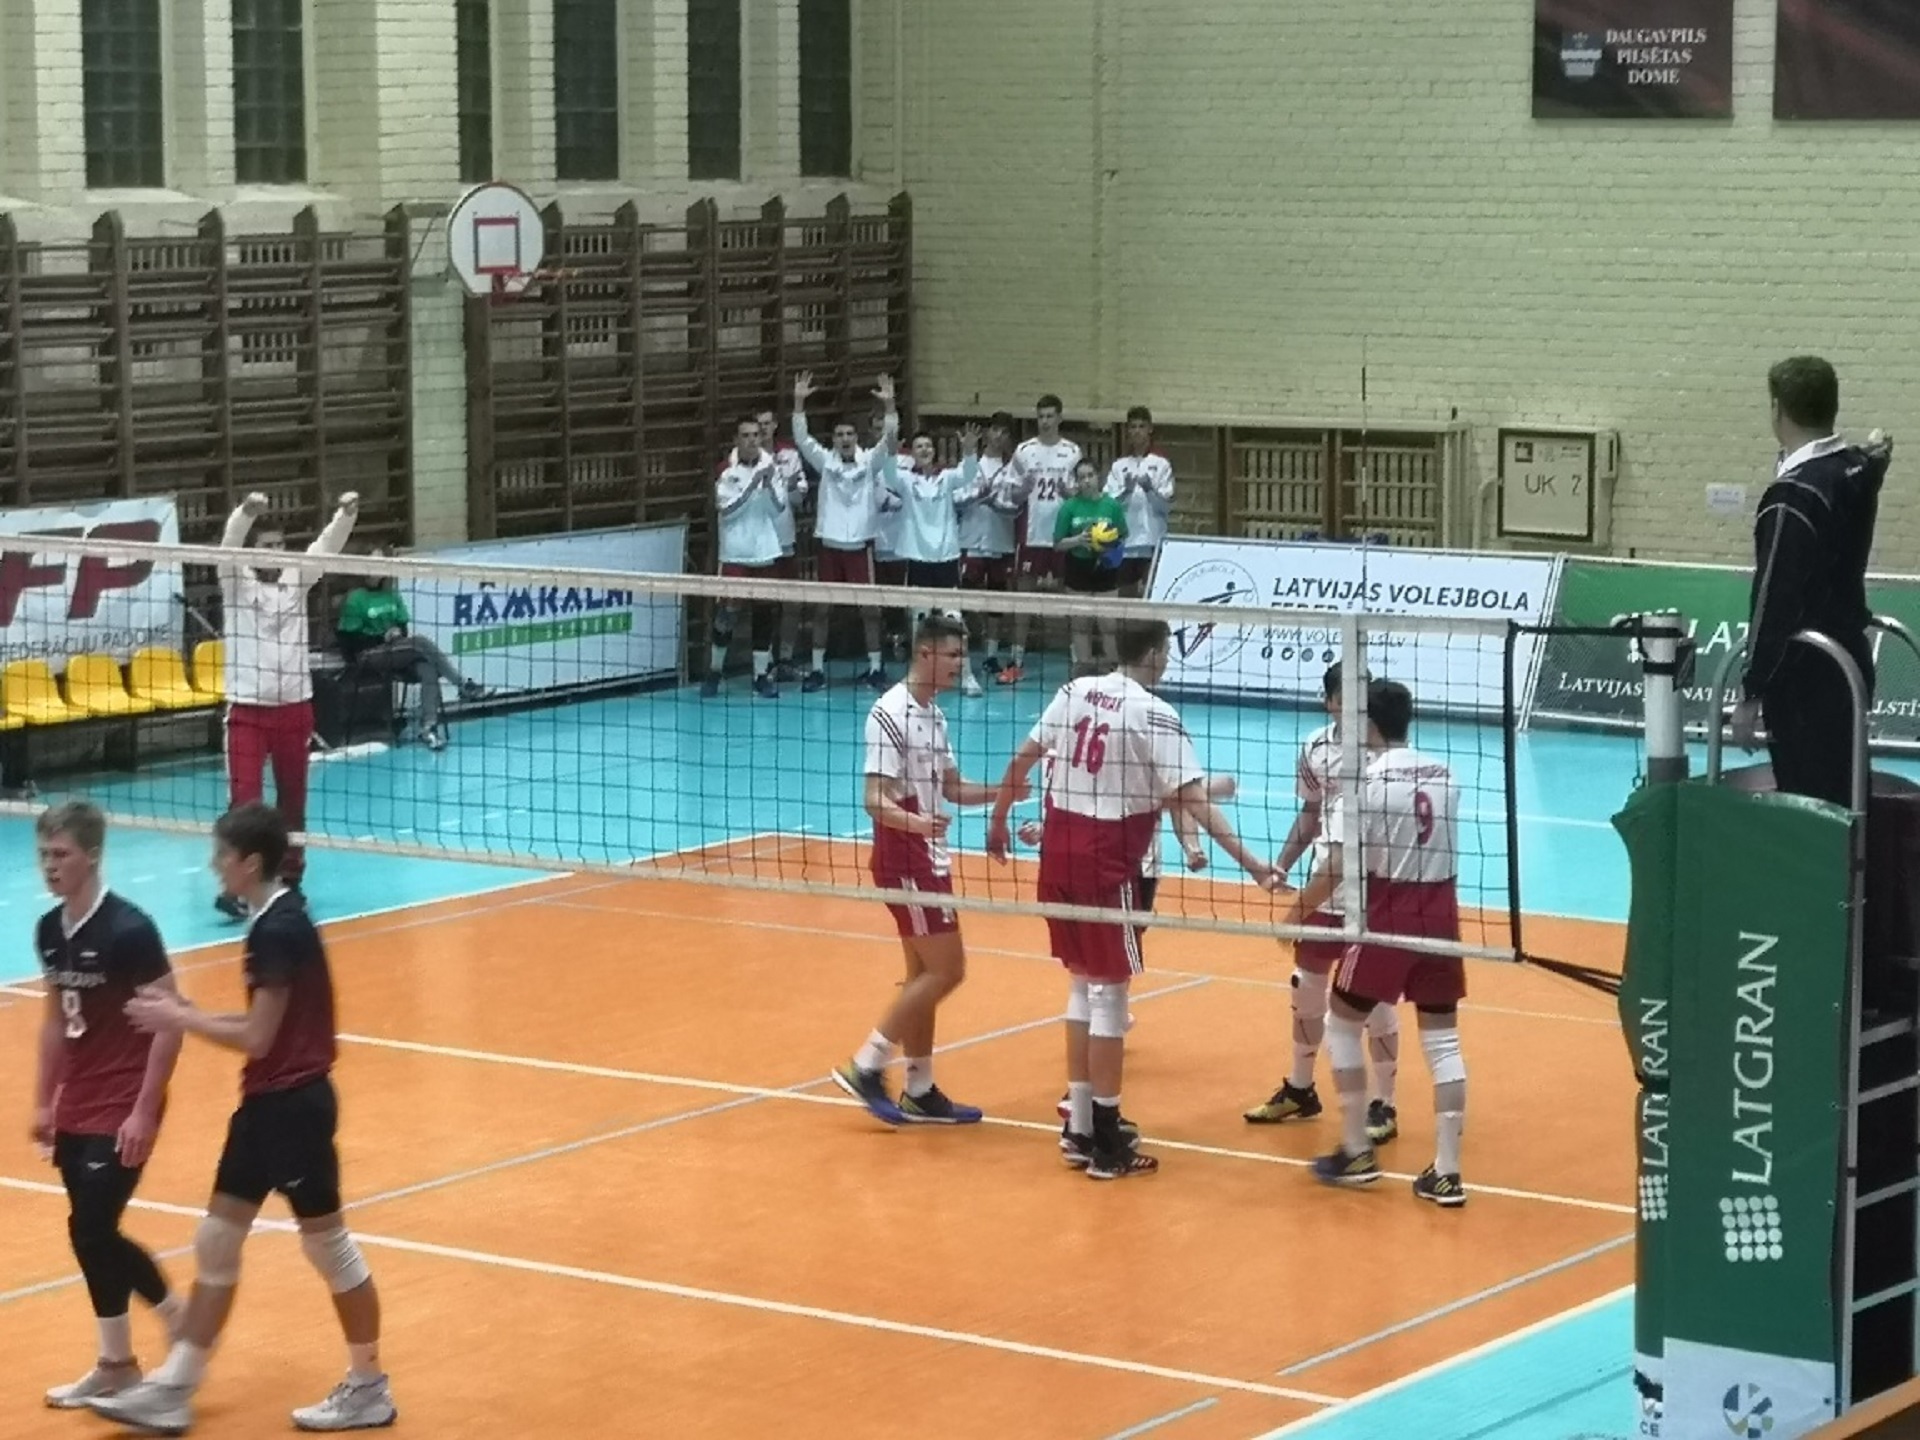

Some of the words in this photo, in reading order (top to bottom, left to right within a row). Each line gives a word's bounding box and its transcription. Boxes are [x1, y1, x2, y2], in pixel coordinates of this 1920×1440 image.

[1605, 28, 1707, 44] DAUGAVPILS
[1616, 47, 1693, 64] PILSĒTAS
[1627, 67, 1680, 85] DOME
[1037, 477, 1056, 501] 22
[1525, 474, 1557, 497] UK
[1273, 577, 1383, 601] LATVIJAS
[1389, 583, 1530, 612] VOLEJBOLA
[1558, 672, 1643, 698] LATVIJAS
[1071, 715, 1110, 775] 16
[1414, 791, 1434, 845] 9
[1731, 931, 1780, 1186] LATGRAN
[1639, 997, 1670, 1168] LATRAN
